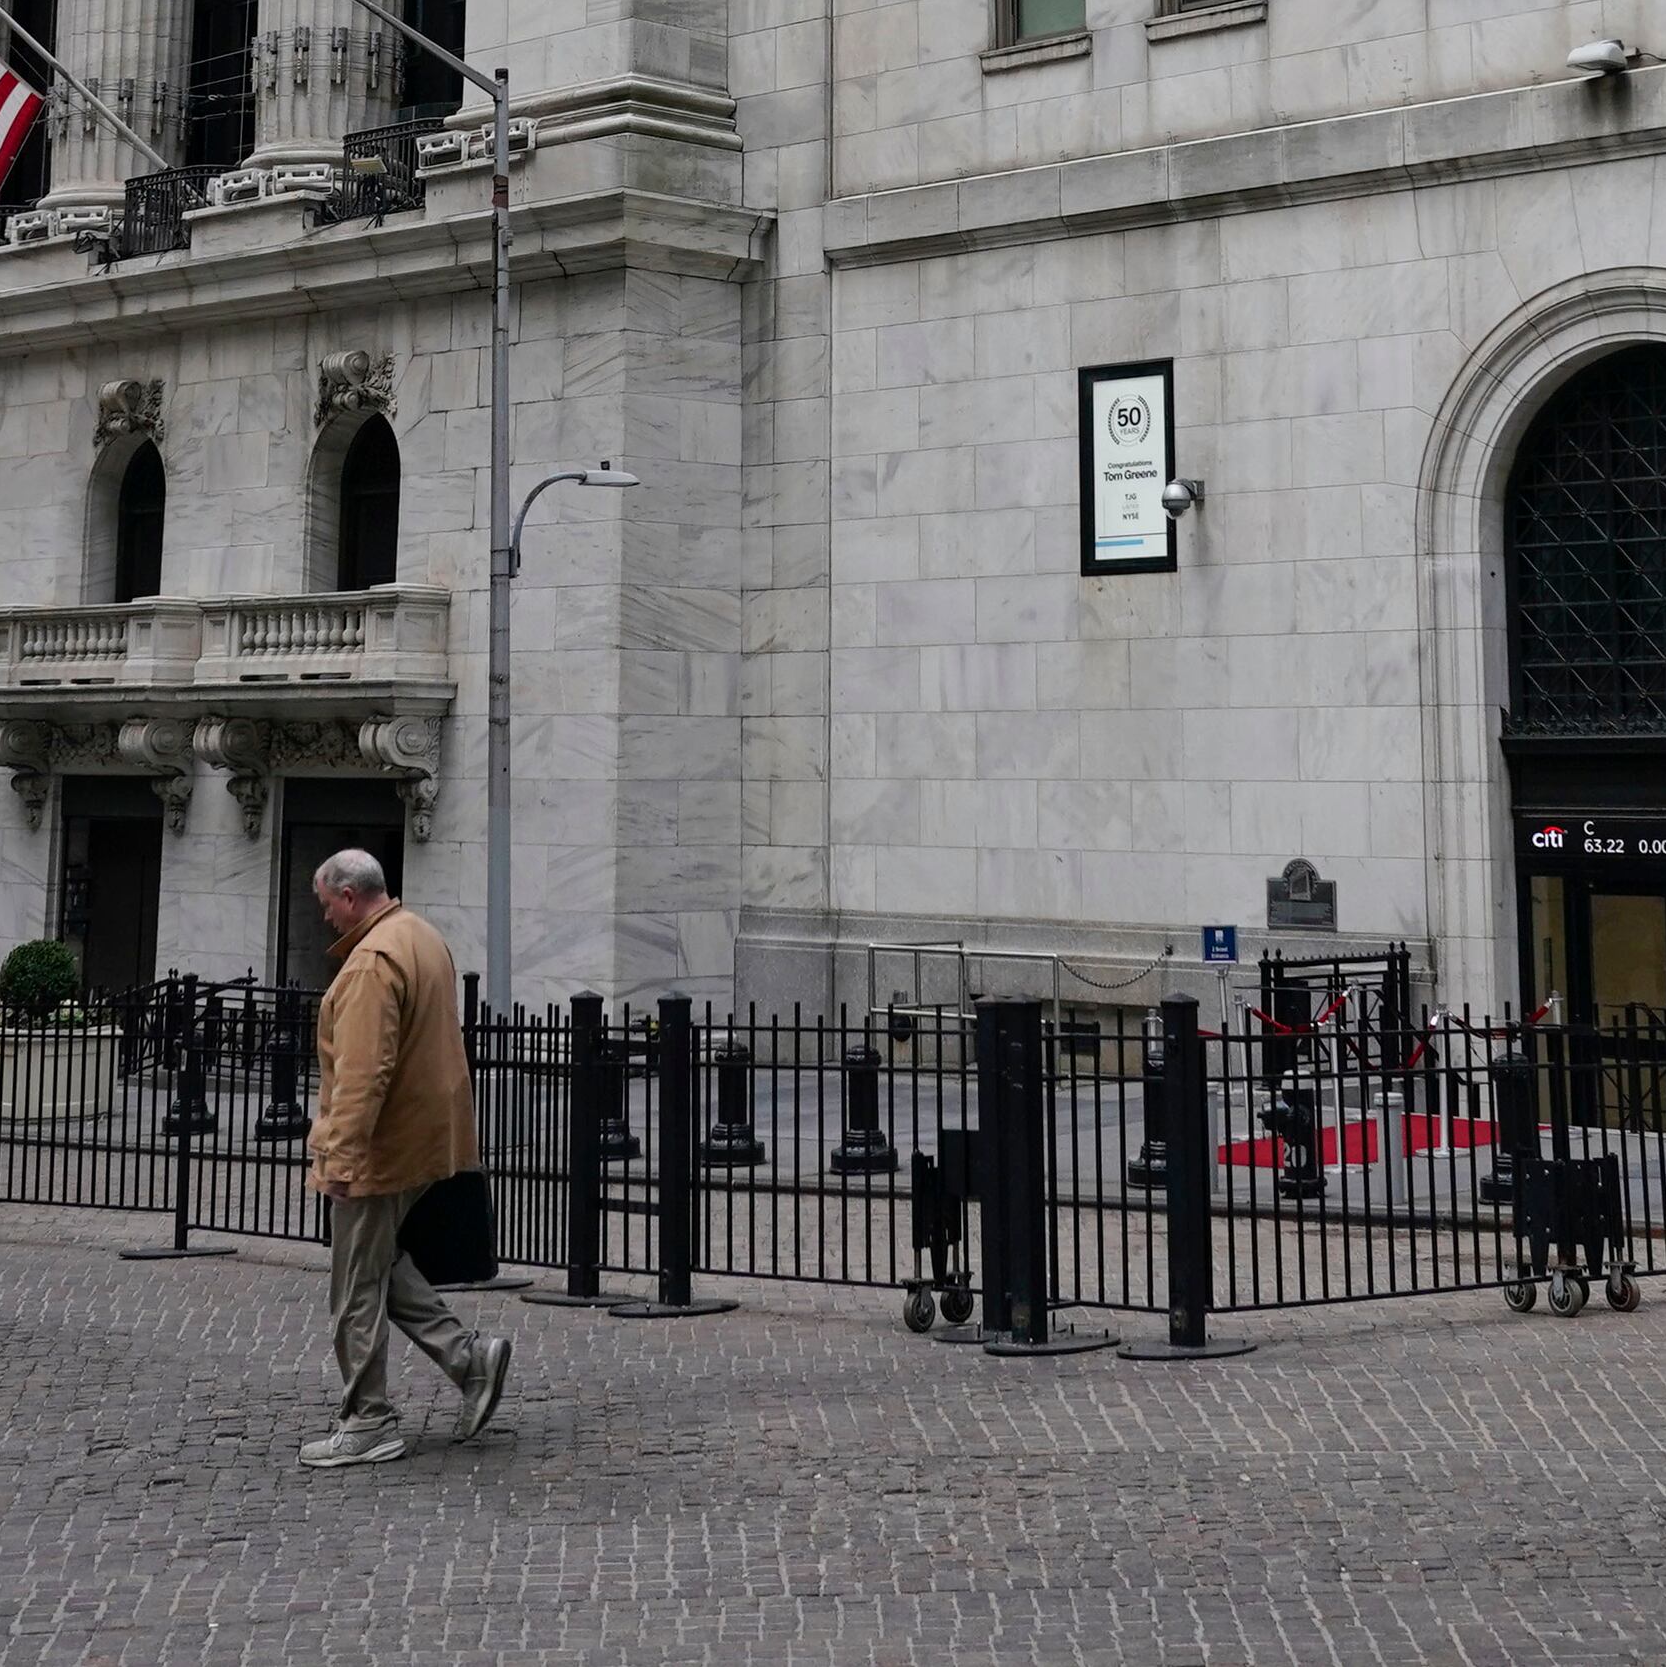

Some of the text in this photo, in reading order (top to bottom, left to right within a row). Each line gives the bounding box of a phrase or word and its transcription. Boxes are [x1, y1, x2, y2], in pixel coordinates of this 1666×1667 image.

[1117, 406, 1141, 427] 50
[1120, 426, 1140, 435] YEARS
[1108, 460, 1152, 470] Congratulations
[1103, 470, 1158, 481] Tom Greene
[1583, 821, 1595, 835] C
[1532, 826, 1564, 848] citi
[1583, 838, 1625, 854] 63.22
